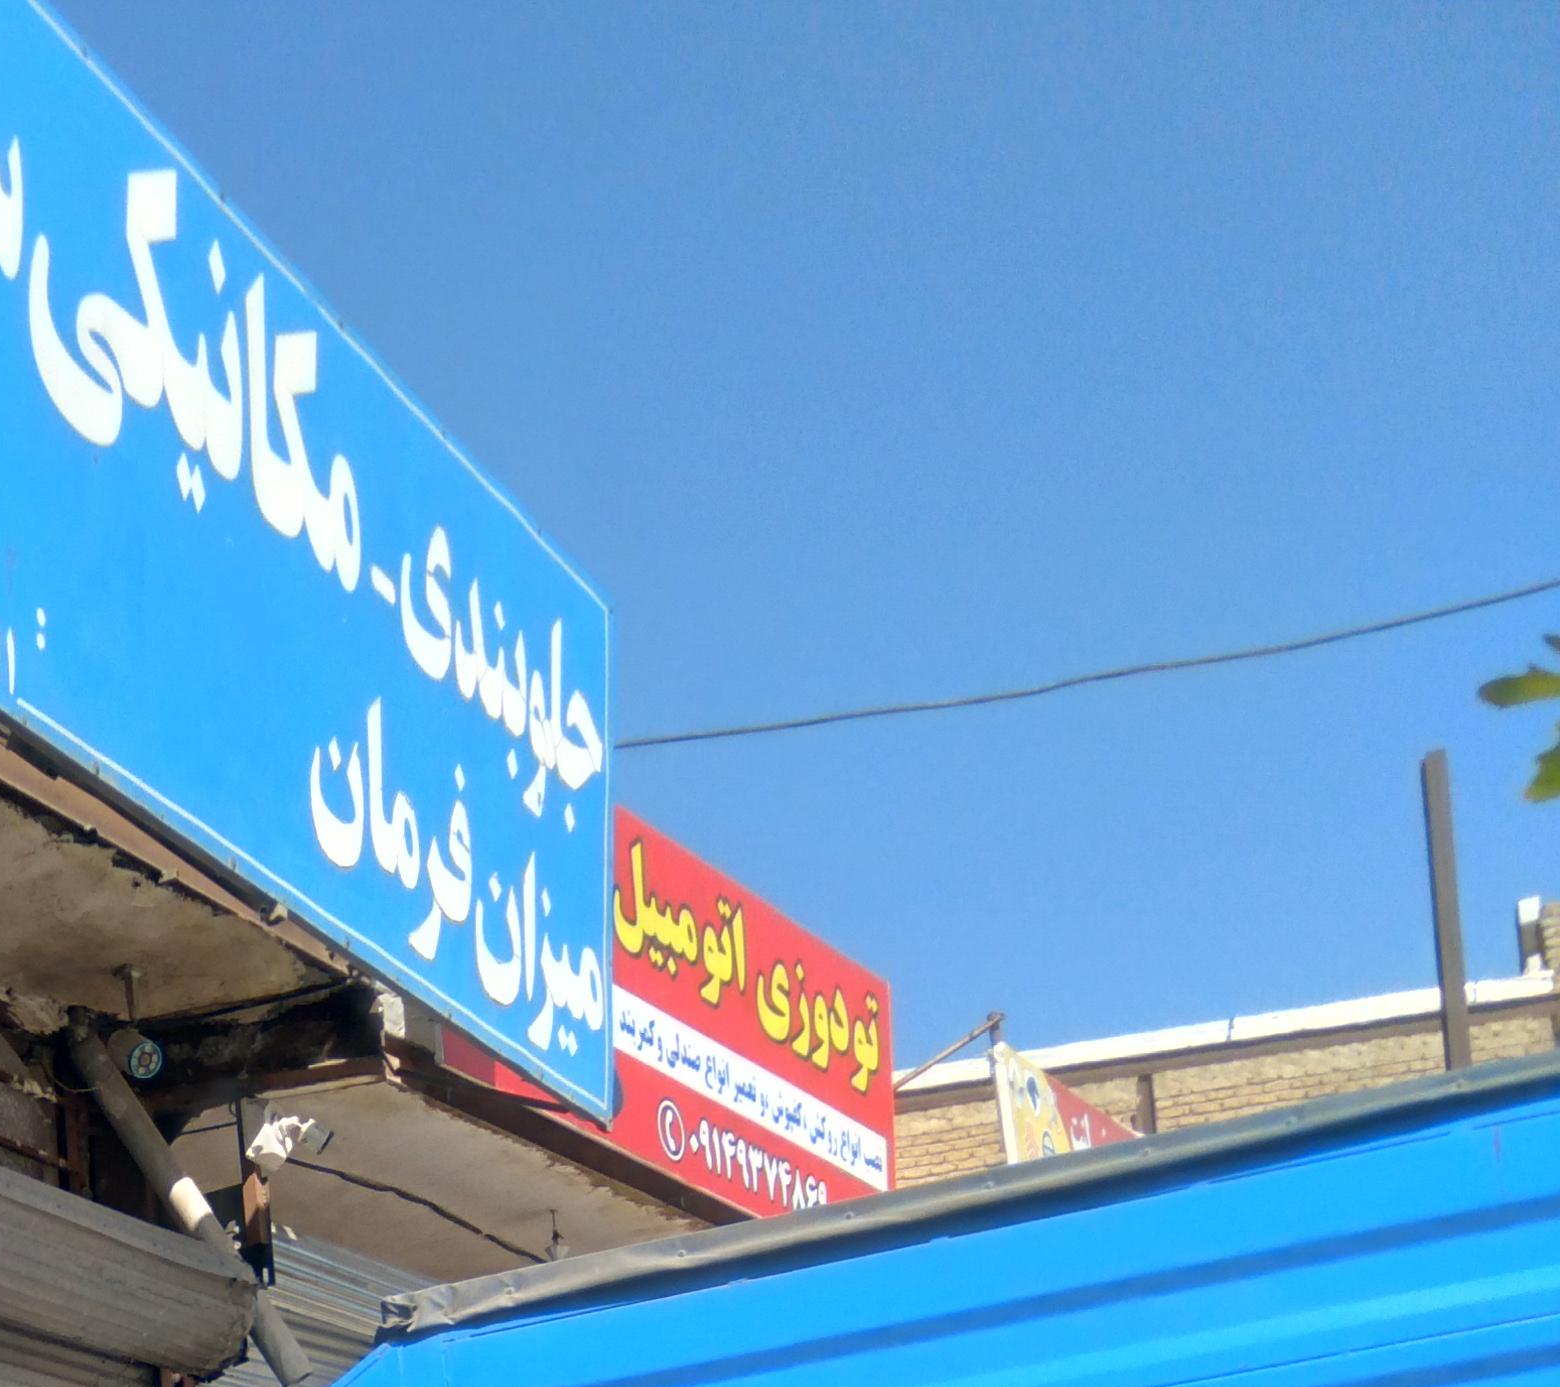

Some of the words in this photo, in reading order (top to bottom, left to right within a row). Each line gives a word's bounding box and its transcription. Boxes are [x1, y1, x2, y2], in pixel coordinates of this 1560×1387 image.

[29, 168, 361, 593] مکانیکی
[400, 523, 603, 834] جلوبندی
[309, 695, 473, 961] فرمان
[475, 850, 604, 1058] میزان
